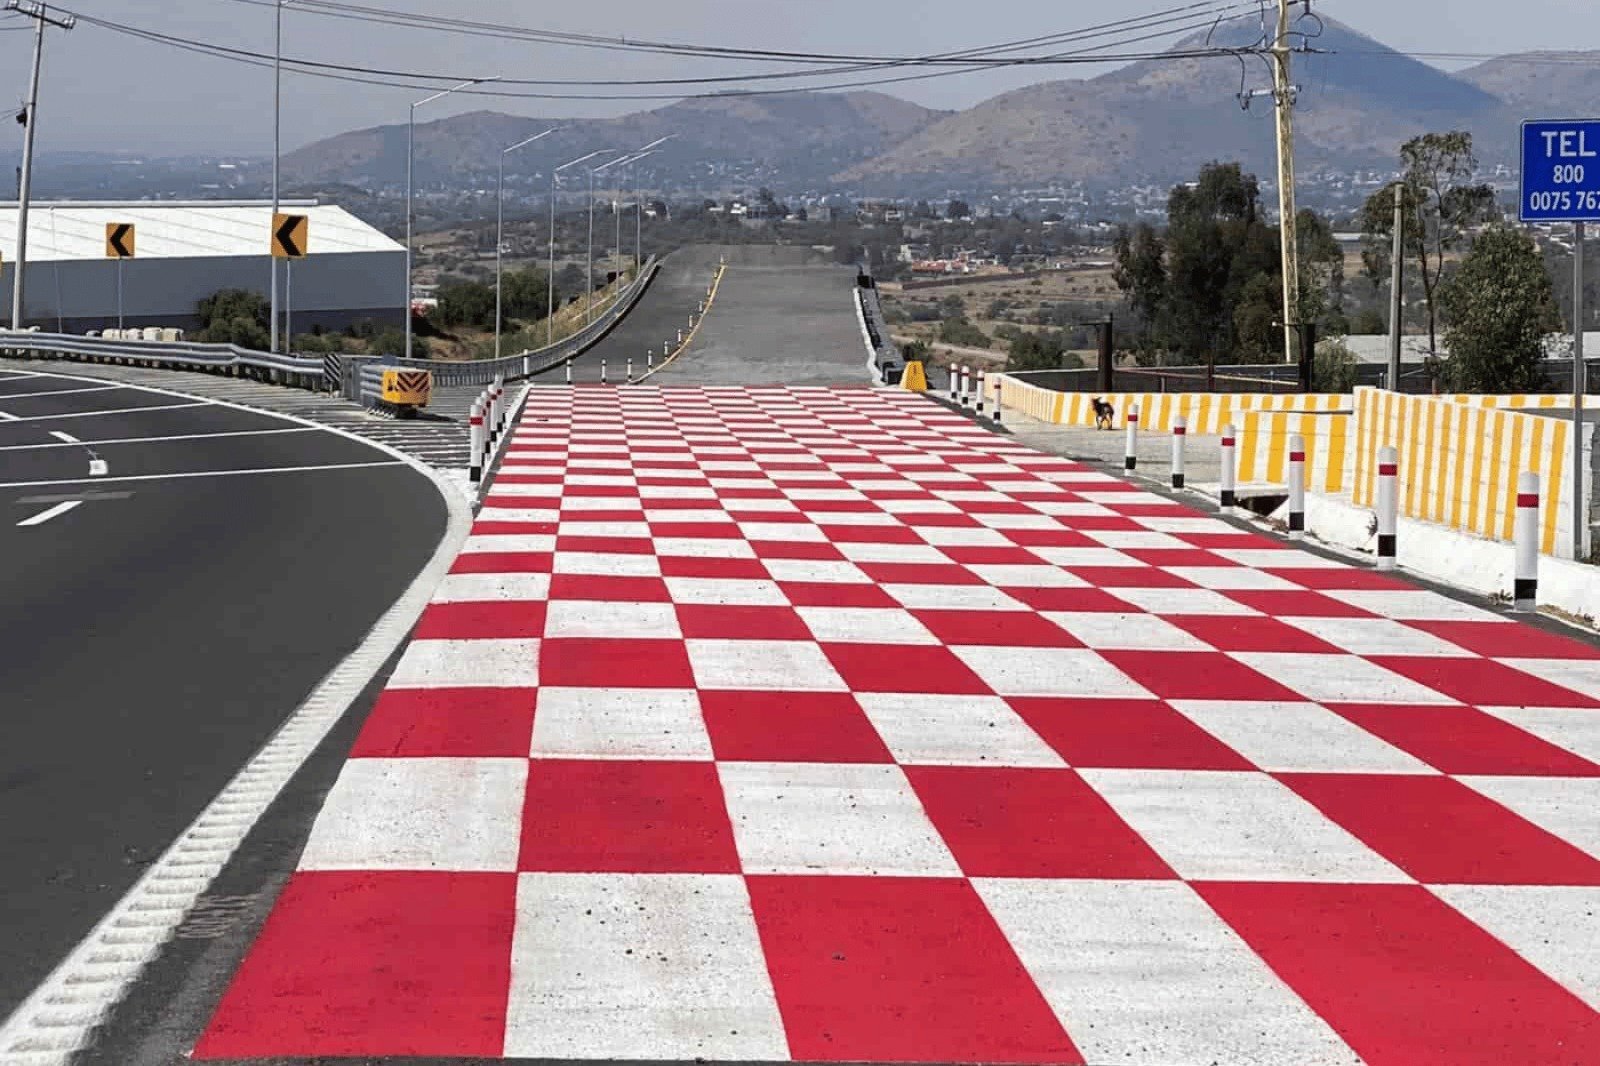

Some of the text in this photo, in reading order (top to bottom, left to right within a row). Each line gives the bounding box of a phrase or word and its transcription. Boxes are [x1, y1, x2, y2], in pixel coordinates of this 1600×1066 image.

[1541, 130, 1597, 157] TEL
[1553, 164, 1584, 183] 800
[1530, 191, 1570, 210] 0075
